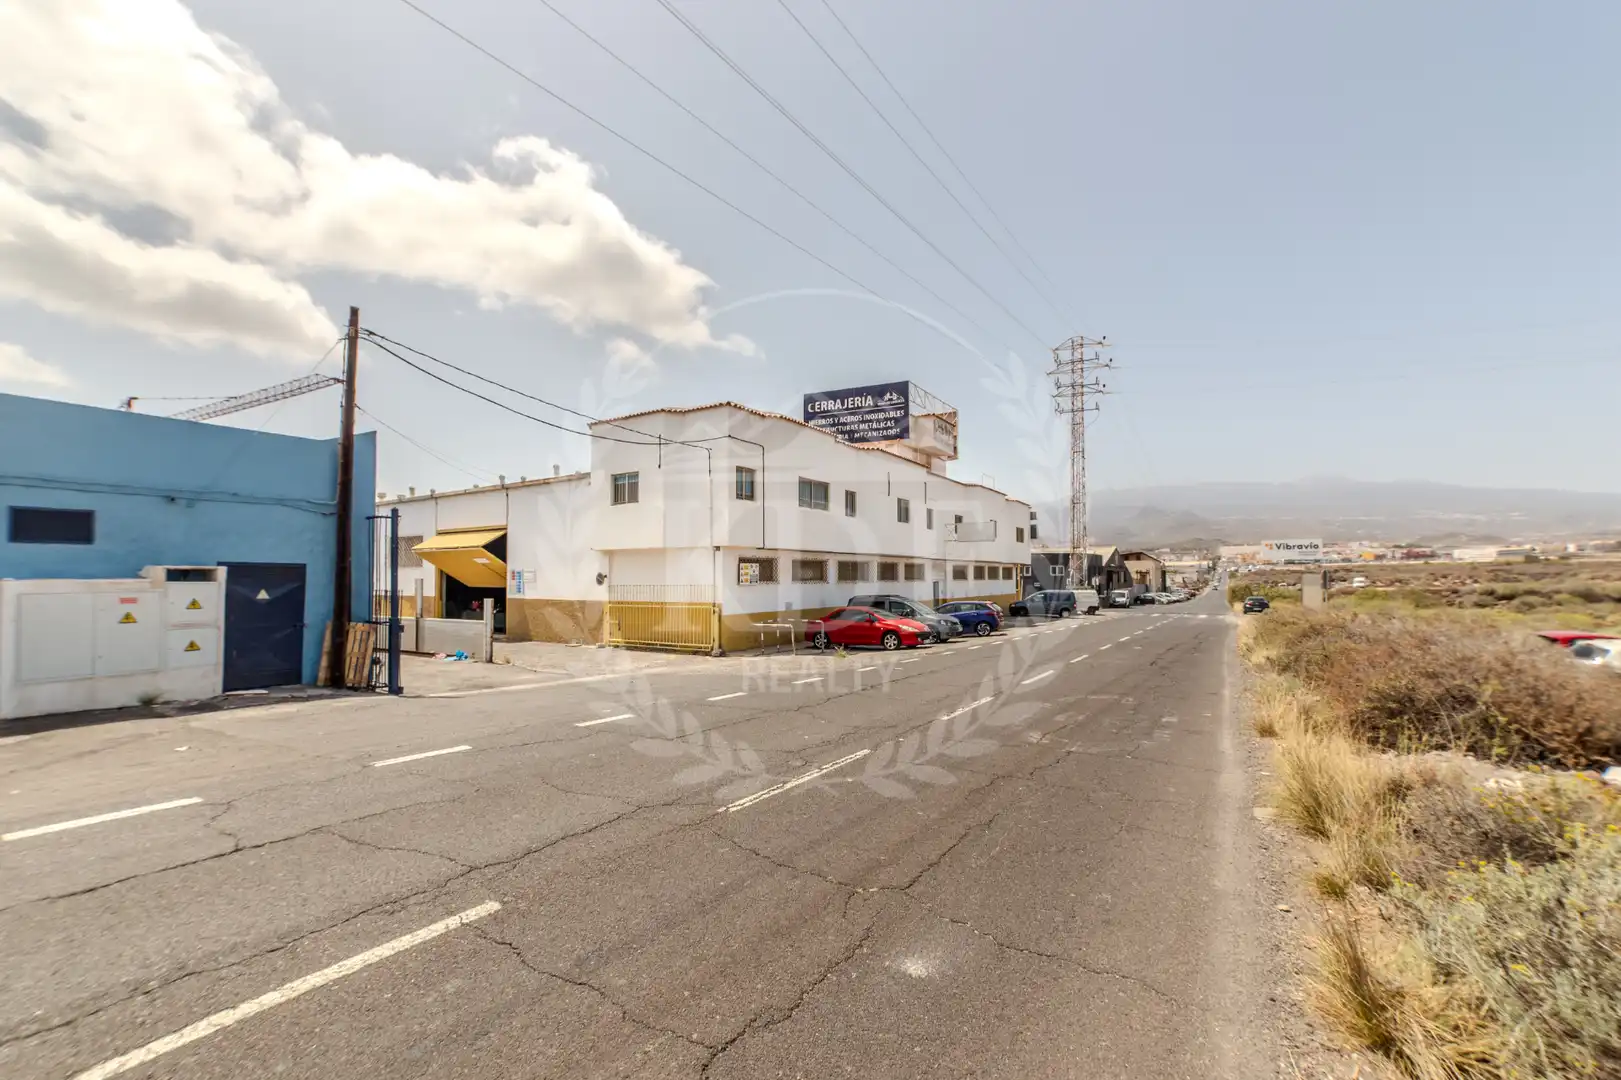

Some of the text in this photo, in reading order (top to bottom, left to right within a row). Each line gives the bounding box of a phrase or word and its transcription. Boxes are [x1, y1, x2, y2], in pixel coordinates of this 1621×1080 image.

[808, 393, 873, 413] CERRAJERÍA
[808, 418, 834, 427] ERROS
[839, 414, 863, 423] ACEROS
[863, 409, 905, 421] INOXIDABLES
[859, 420, 895, 430] METÁLICAS
